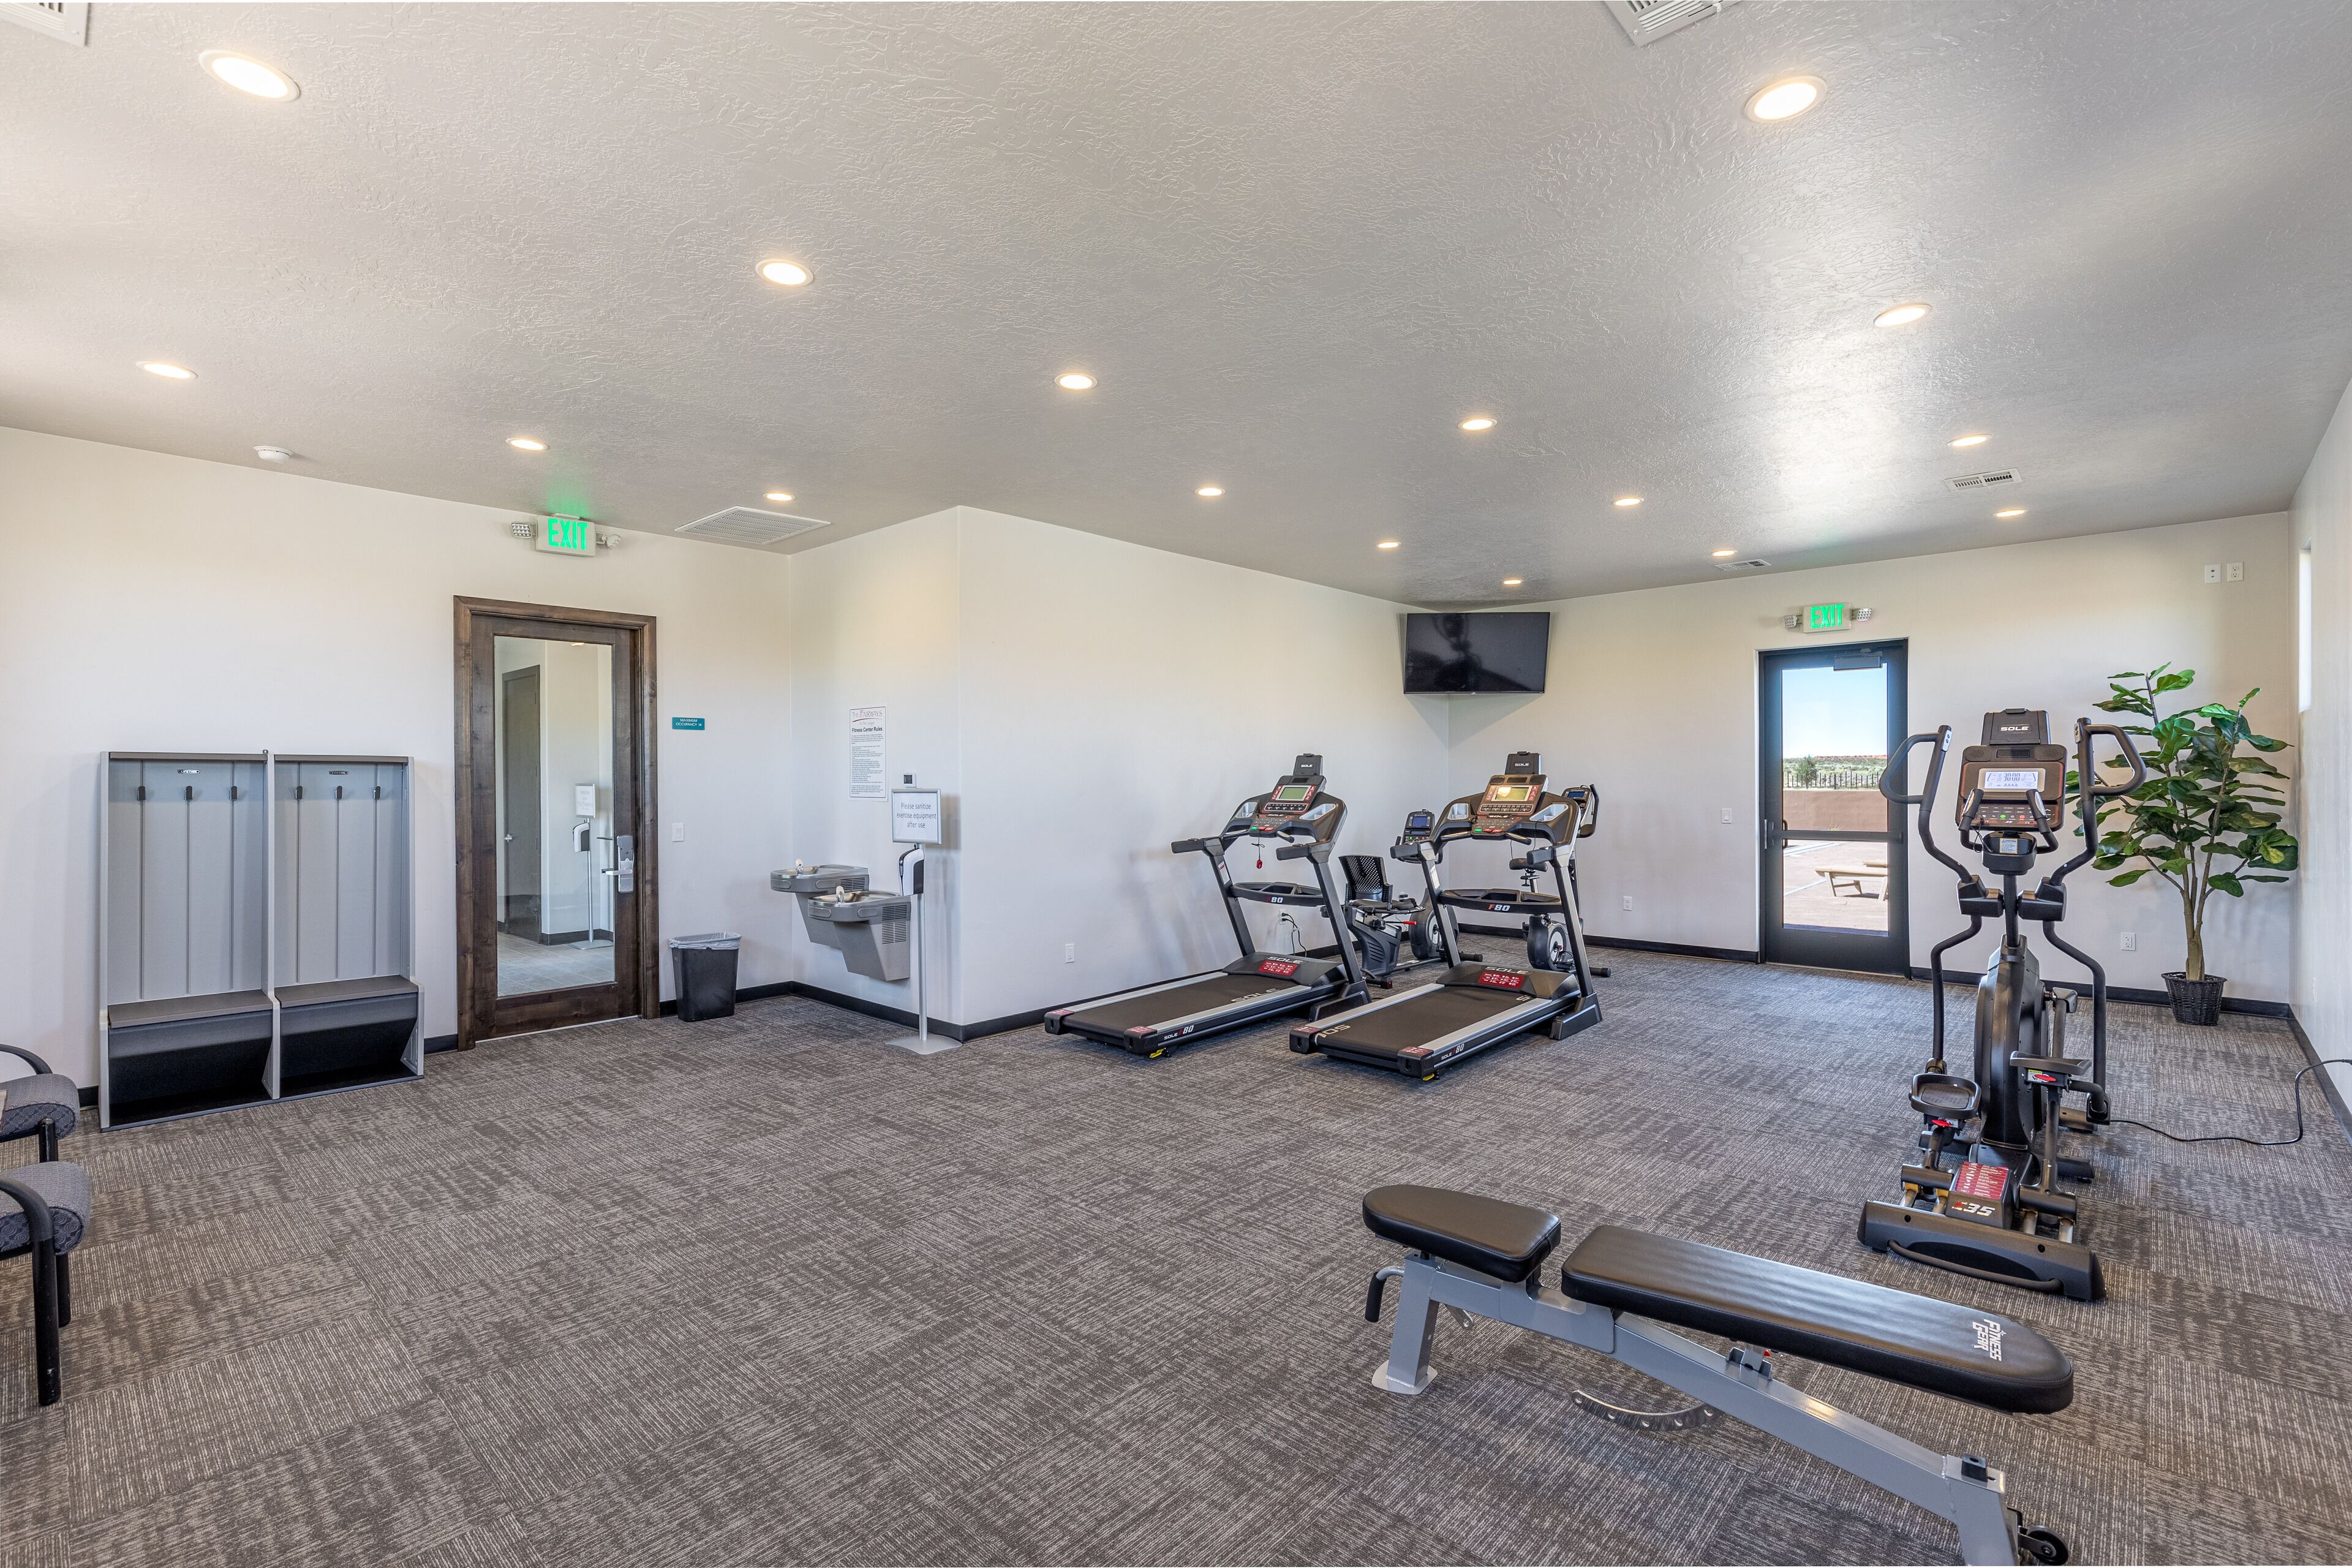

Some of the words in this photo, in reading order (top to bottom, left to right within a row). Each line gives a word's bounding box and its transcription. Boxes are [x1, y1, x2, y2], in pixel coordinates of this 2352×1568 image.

[548, 518, 588, 550] EXIT
[1811, 603, 1844, 628] EXIT
[1485, 966, 1529, 975] SOLE
[1452, 1043, 1464, 1055] 80
[1951, 1201, 1996, 1216] E35
[1972, 1321, 1989, 1351] GEAR
[1983, 1319, 2002, 1362] FITNESS
